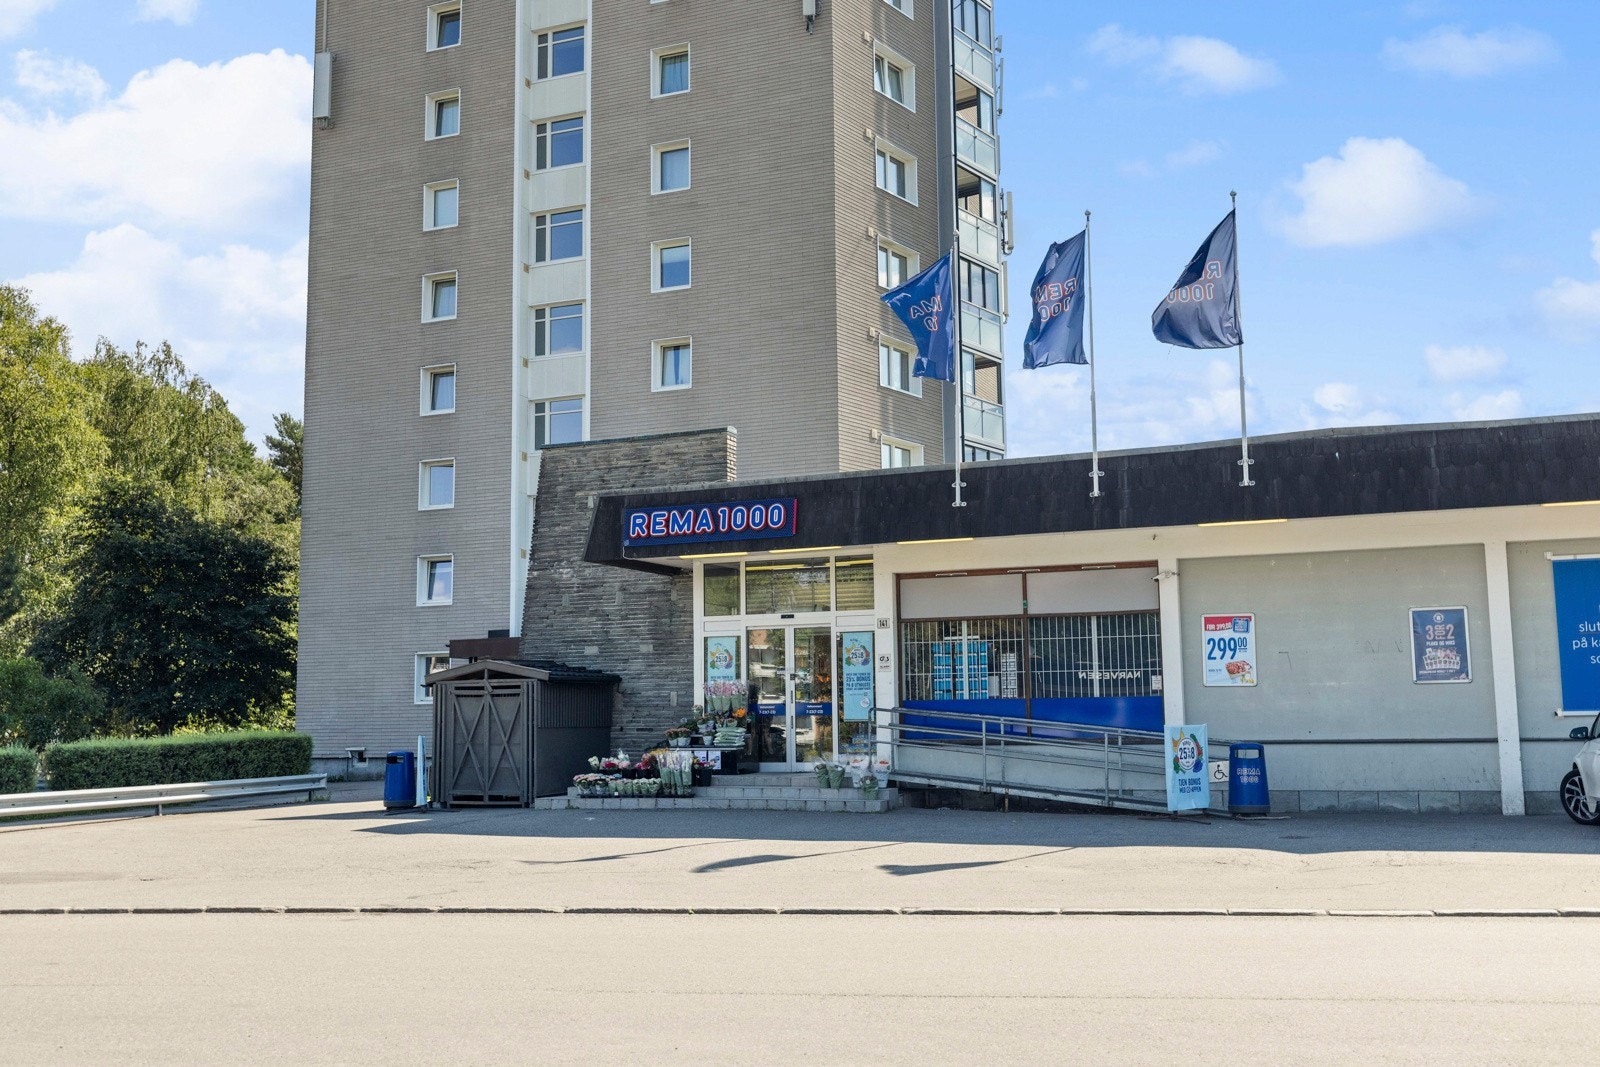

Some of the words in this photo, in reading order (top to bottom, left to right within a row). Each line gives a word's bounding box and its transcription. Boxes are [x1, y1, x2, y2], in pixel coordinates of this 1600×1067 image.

[630, 508, 714, 538] REMA
[718, 504, 785, 531] 1000
[879, 619, 888, 627] 141
[1578, 621, 1600, 632] slut
[1425, 624, 1435, 640] 3
[1434, 624, 1446, 640] FOR
[1446, 624, 1455, 639] 2
[1207, 637, 1237, 660] 299
[1572, 636, 1588, 650] på
[1591, 637, 1600, 648] k
[1179, 748, 1188, 760] 25
[1190, 747, 1195, 759] 8
[1188, 777, 1201, 786] BONUS
